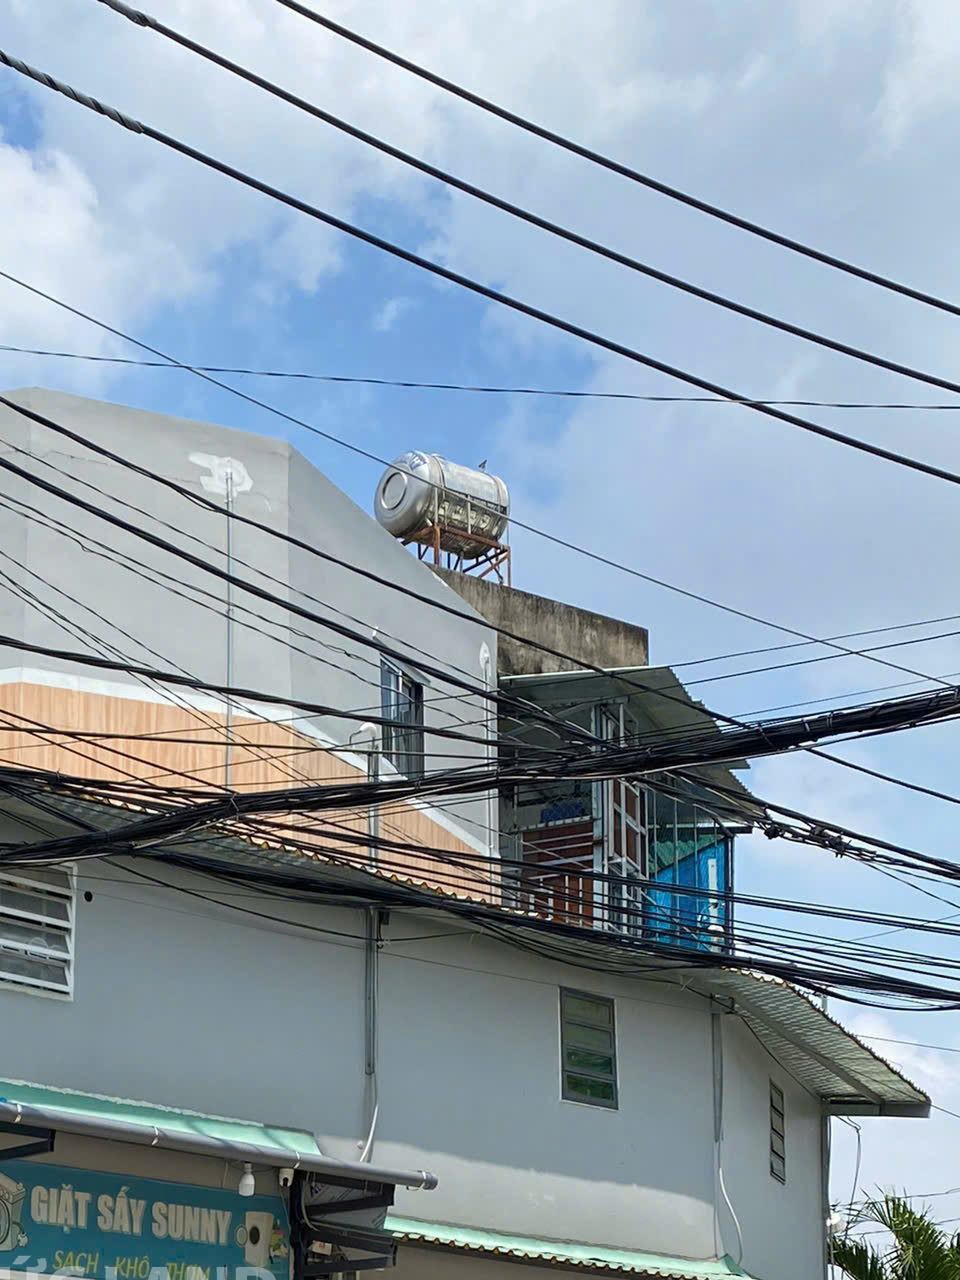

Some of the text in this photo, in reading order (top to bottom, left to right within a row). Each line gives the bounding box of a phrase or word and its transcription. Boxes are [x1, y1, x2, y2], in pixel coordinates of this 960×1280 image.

[31, 1184, 233, 1247] GIẶT SẤY SUNNY
[115, 1255, 150, 1279] KHÔ
